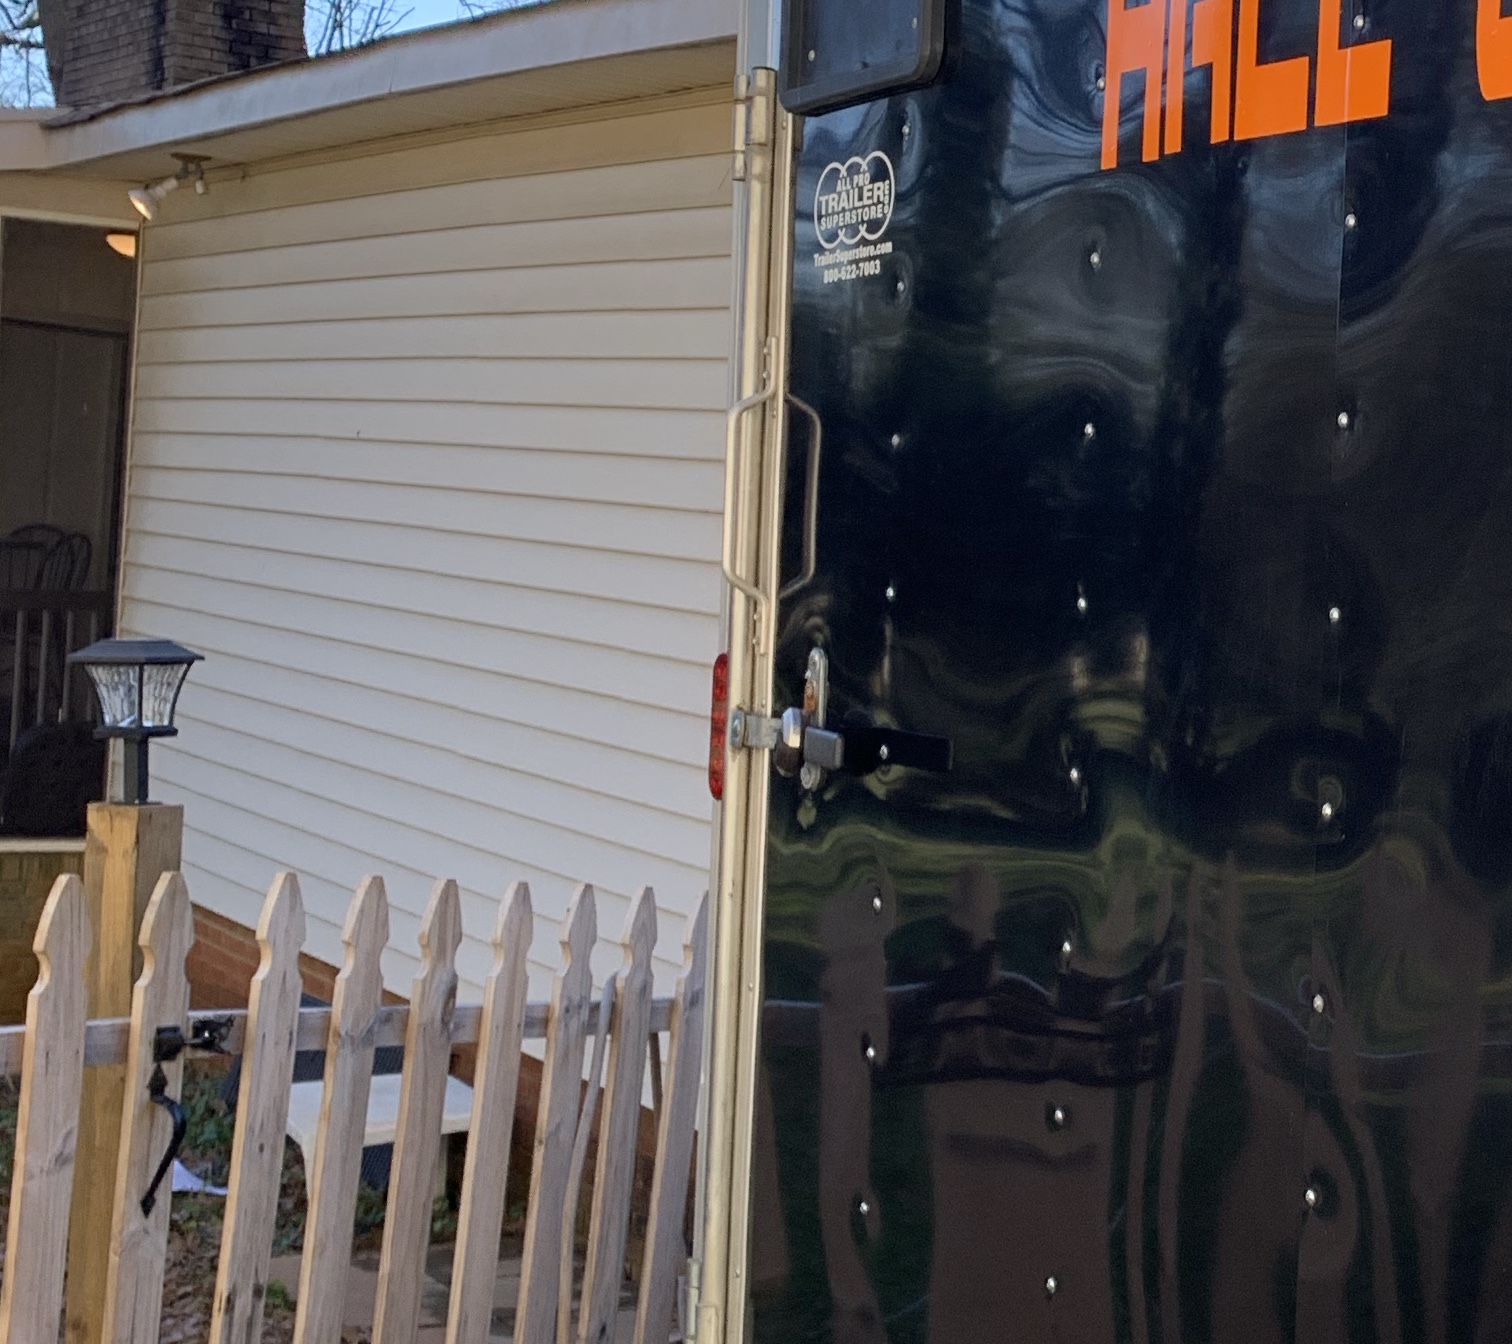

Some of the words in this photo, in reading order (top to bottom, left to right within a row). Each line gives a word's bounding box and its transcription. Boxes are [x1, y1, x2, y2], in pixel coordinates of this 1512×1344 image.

[835, 175, 852, 193] ALL
[853, 172, 870, 188] PRO
[818, 181, 884, 216] TRAILER
[820, 203, 884, 231] SUPERSTORE
[813, 241, 893, 267] TrailerSuperstore.com
